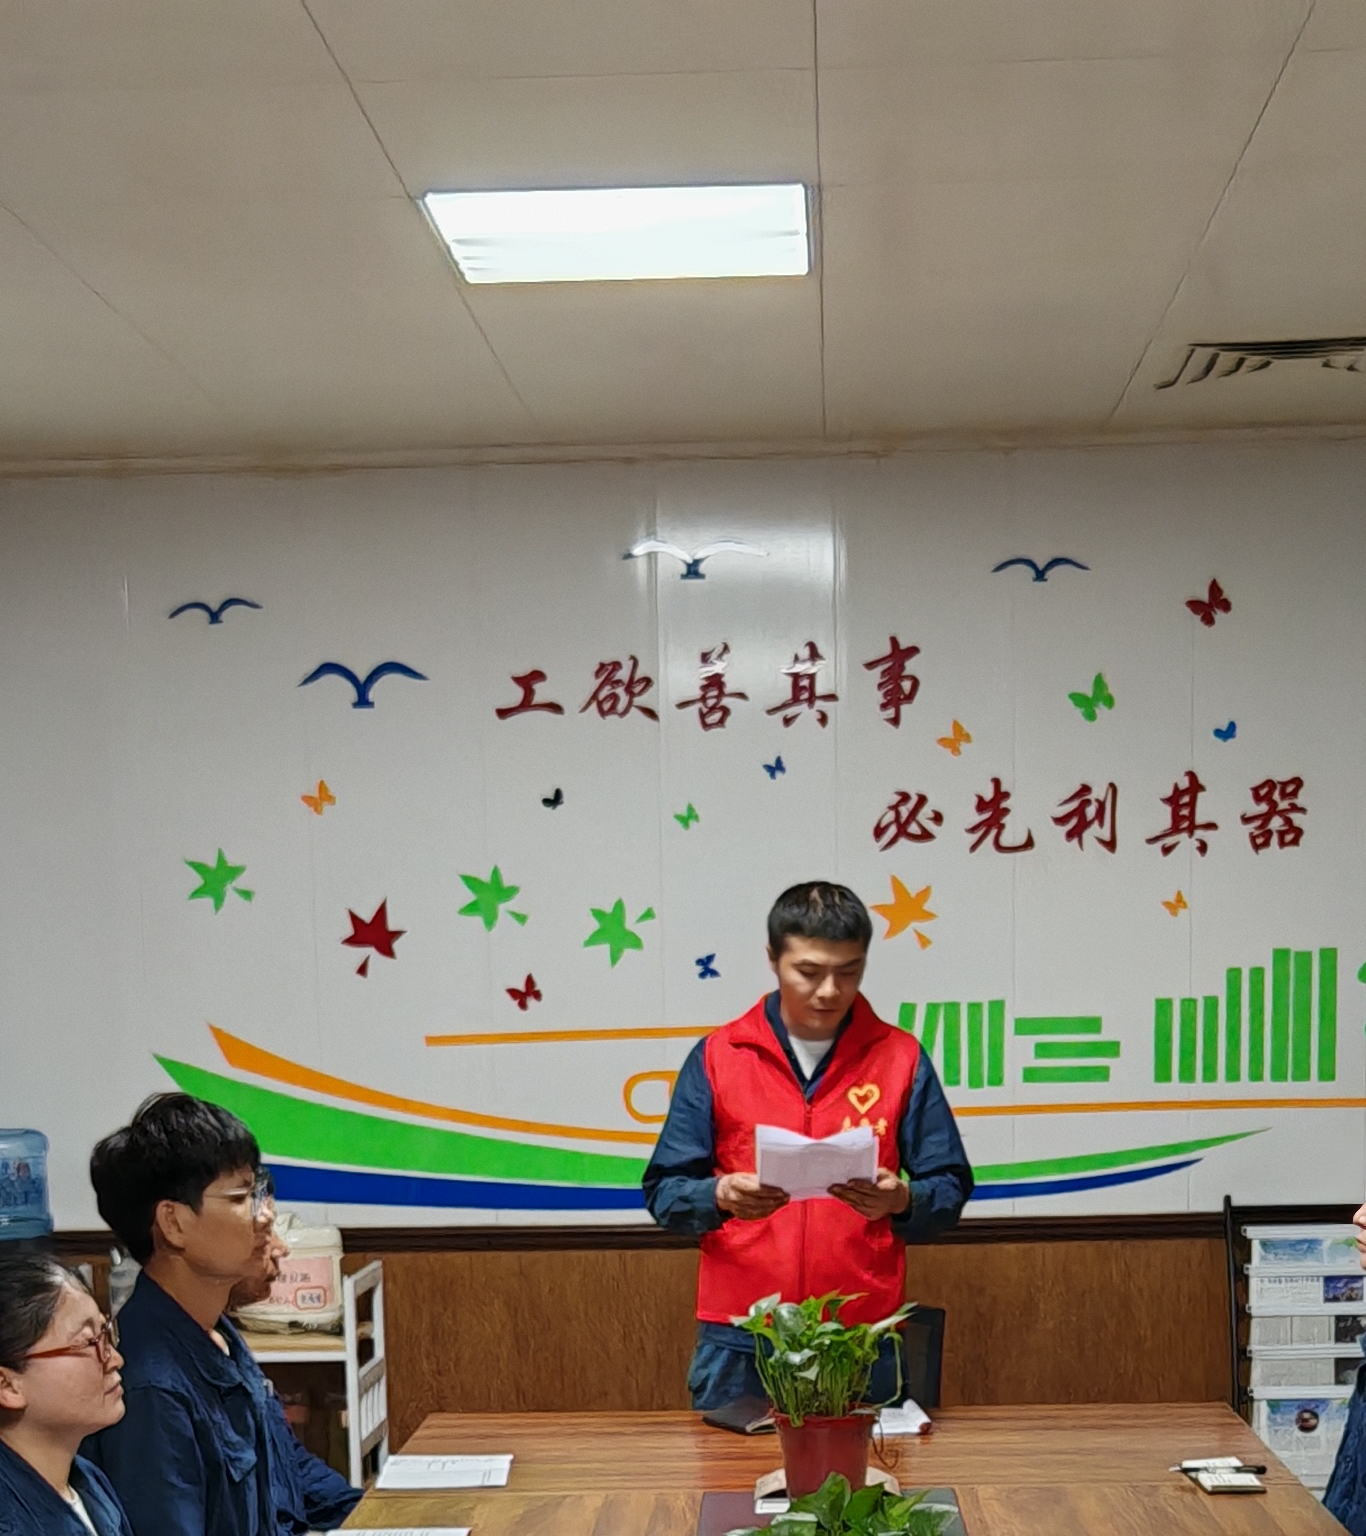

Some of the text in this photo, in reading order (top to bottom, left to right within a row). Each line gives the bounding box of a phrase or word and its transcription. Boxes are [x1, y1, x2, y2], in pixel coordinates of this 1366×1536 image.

[495, 636, 921, 729] 工欲善其事
[873, 770, 1308, 857] 必先利其器
